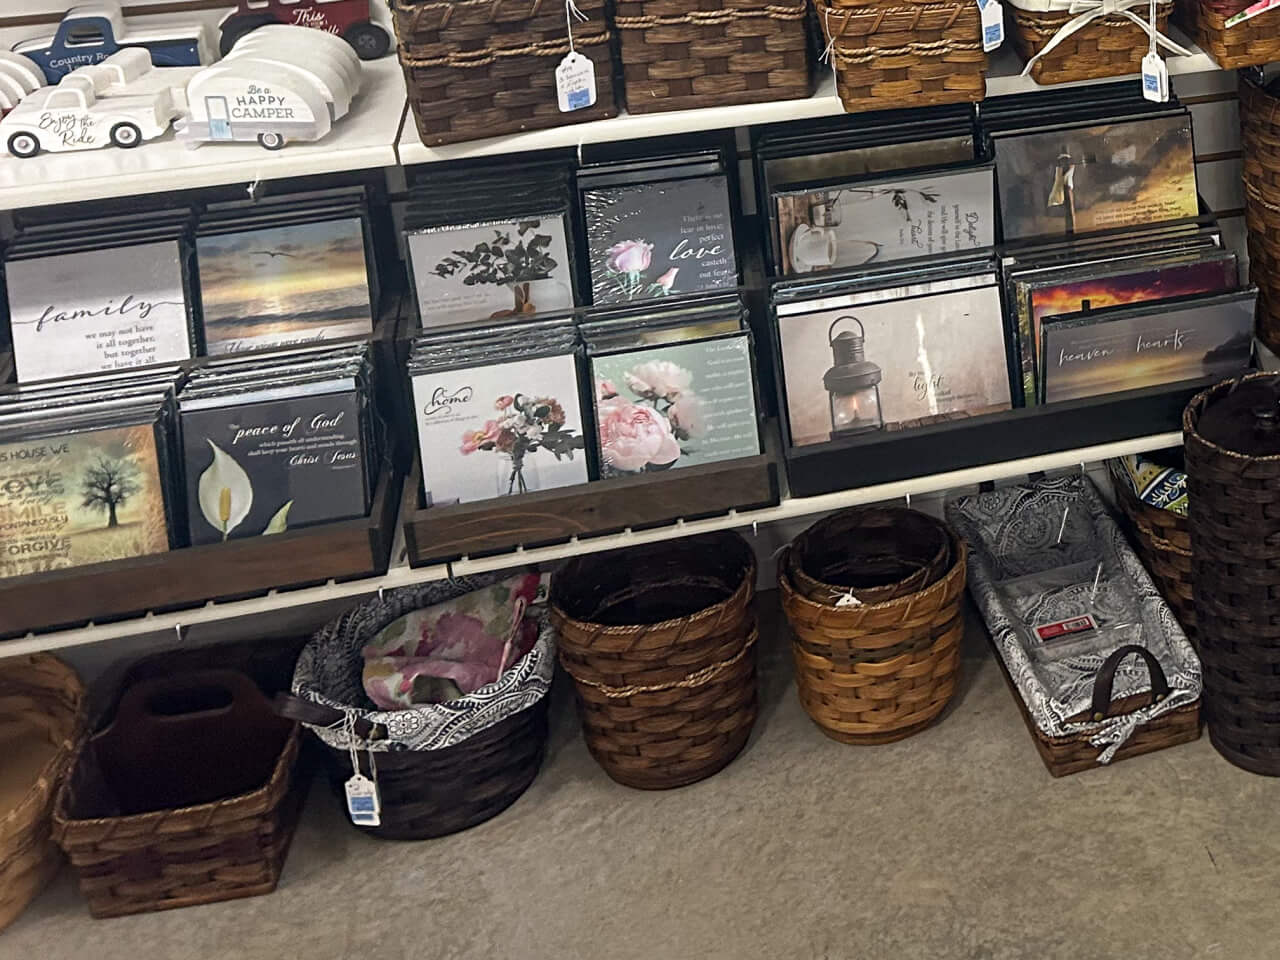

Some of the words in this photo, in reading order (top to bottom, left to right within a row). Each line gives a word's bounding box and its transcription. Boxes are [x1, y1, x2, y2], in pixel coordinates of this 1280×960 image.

[292, 6, 326, 25] This
[49, 53, 94, 69] Country
[247, 83, 262, 96] Be
[263, 86, 271, 95] a
[236, 95, 286, 107] HAPPY
[38, 112, 77, 132] Enjoy
[77, 112, 97, 129] the
[231, 106, 296, 120] CAMPER
[58, 125, 96, 147] Ride
[668, 238, 726, 261] love
[33, 294, 160, 333] family
[99, 330, 117, 339] may
[118, 326, 133, 335] not
[135, 324, 154, 334] have
[105, 338, 117, 349] all
[1058, 347, 1115, 368] heaven
[1136, 327, 1196, 353] hearts
[103, 350, 119, 360] but
[121, 346, 157, 359] together
[423, 385, 473, 416] home
[232, 424, 279, 445] peace
[281, 416, 302, 438] of
[309, 410, 345, 432] God
[10, 446, 47, 459] HOUSE
[49, 443, 71, 455] WE
[289, 454, 320, 466] Christ
[330, 448, 356, 464] Jesus
